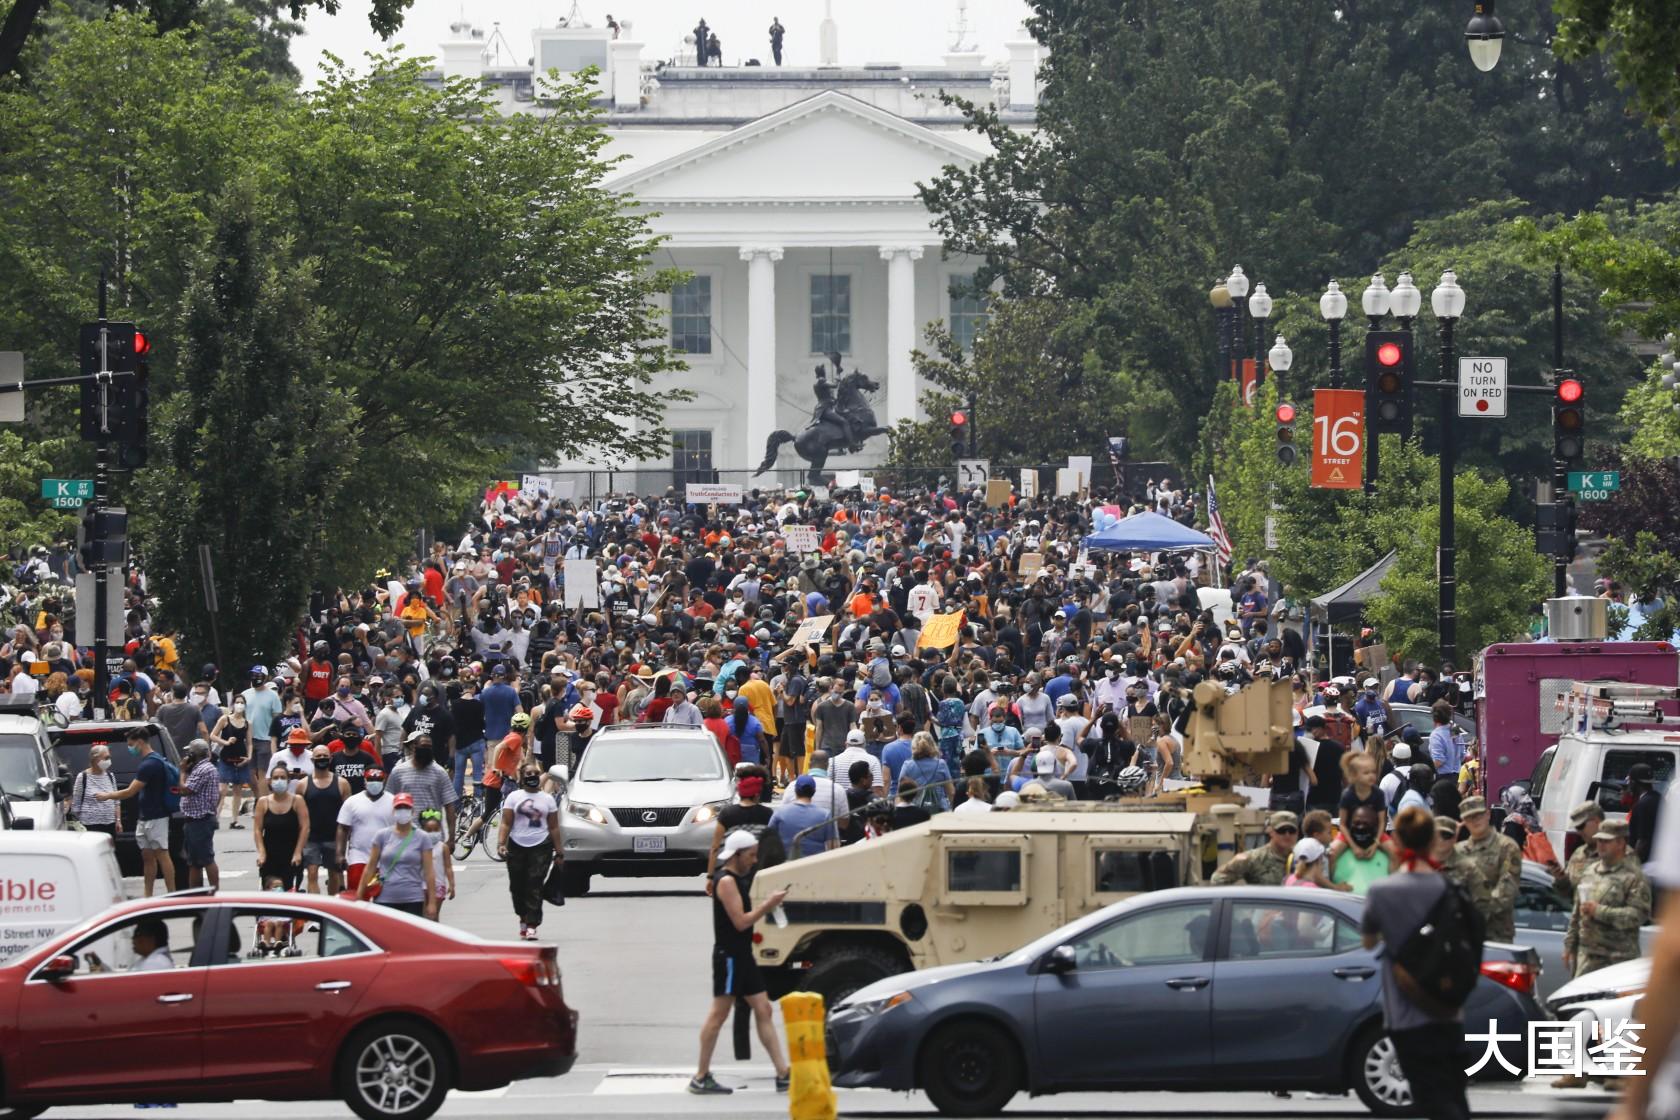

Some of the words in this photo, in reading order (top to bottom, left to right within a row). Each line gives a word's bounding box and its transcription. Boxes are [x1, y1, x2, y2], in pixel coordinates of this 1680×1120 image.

[1473, 362, 1493, 374] NO
[1469, 376, 1496, 385] TURN
[1463, 388, 1477, 398] ON
[1482, 388, 1502, 398] RED
[1314, 415, 1360, 456] 16
[1582, 474, 1594, 488] K
[58, 482, 70, 496] K
[1579, 489, 1608, 500] 1600
[54, 497, 83, 507] 1500
[918, 596, 926, 611] 7
[312, 670, 330, 679] OBEY
[4, 928, 35, 940] Street
[37, 928, 55, 938] NW
